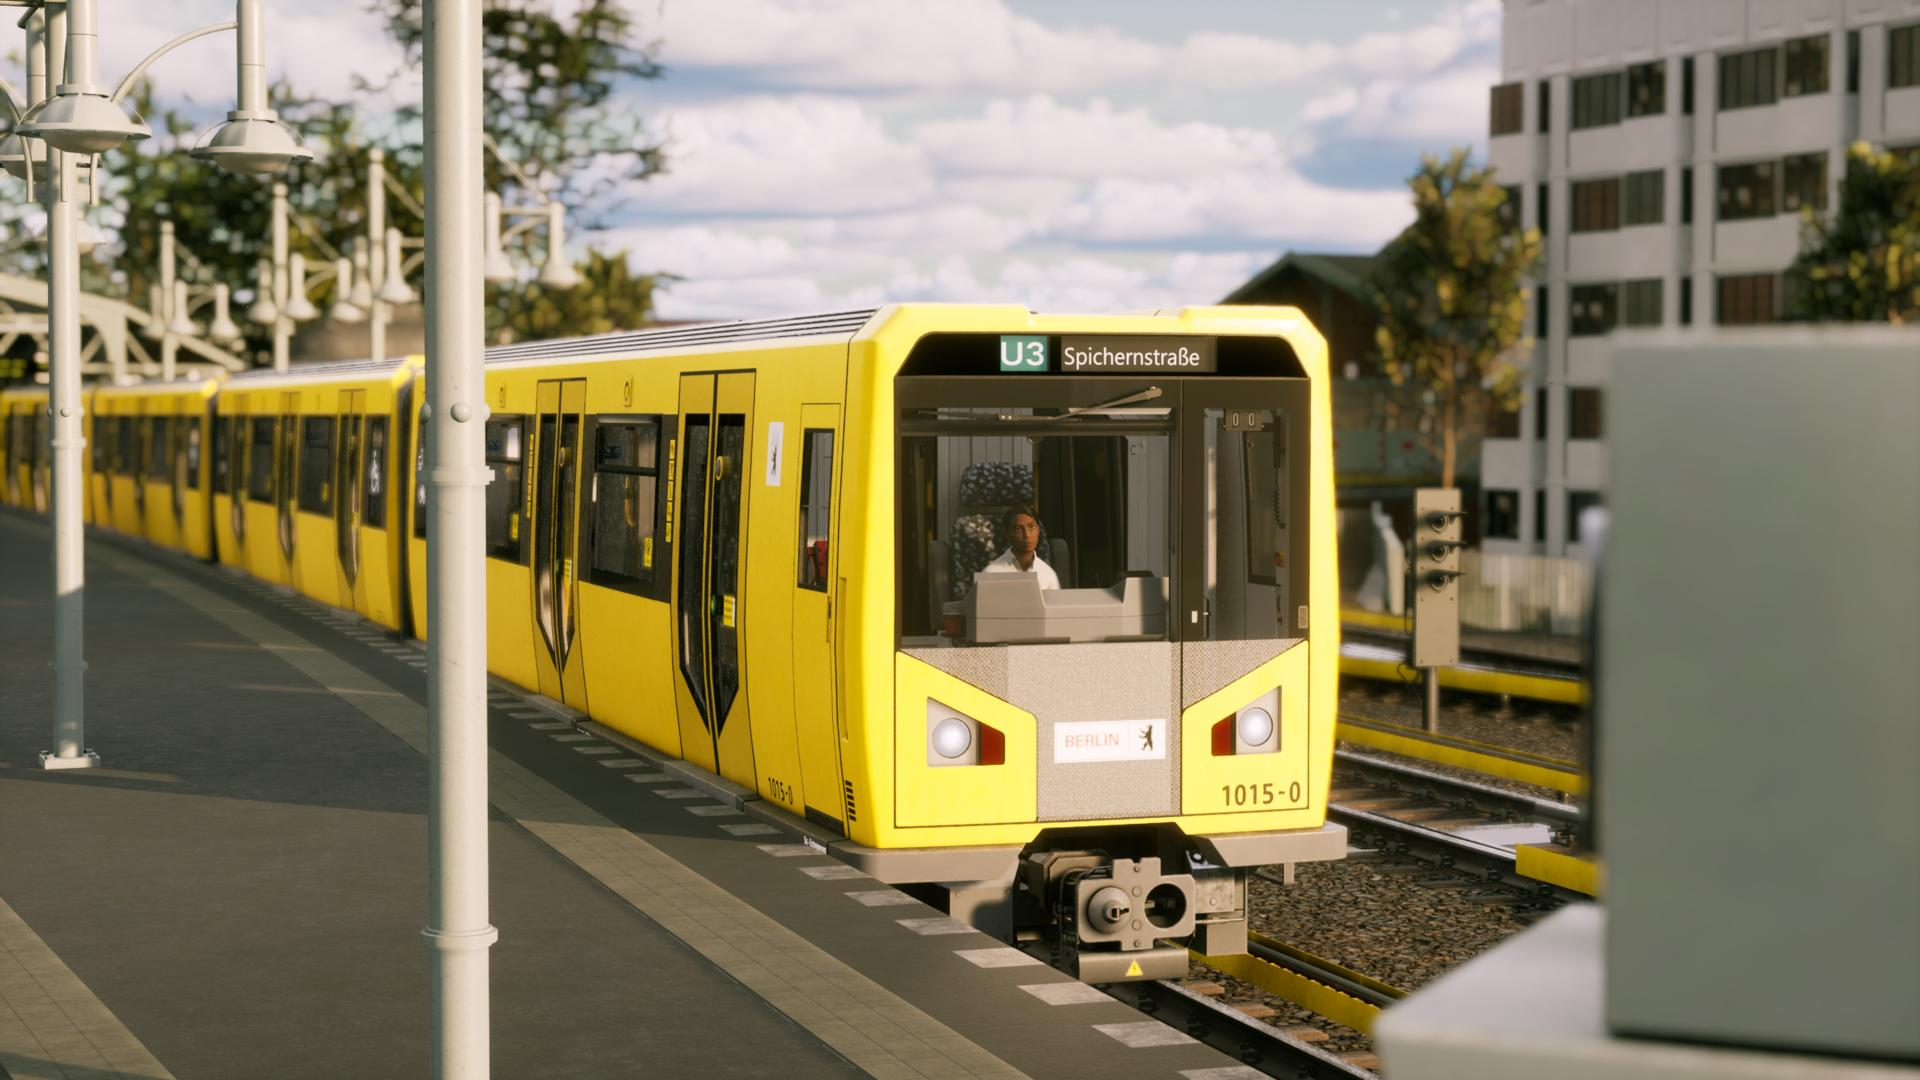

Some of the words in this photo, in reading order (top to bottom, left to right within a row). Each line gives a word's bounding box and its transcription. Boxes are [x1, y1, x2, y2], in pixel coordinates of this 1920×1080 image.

[1001, 341, 1045, 366] U3
[1064, 346, 1200, 370] Spichernstraße
[1065, 733, 1120, 748] BERLIN
[768, 777, 793, 805] 1015-0
[1222, 781, 1301, 806] 1015-0
